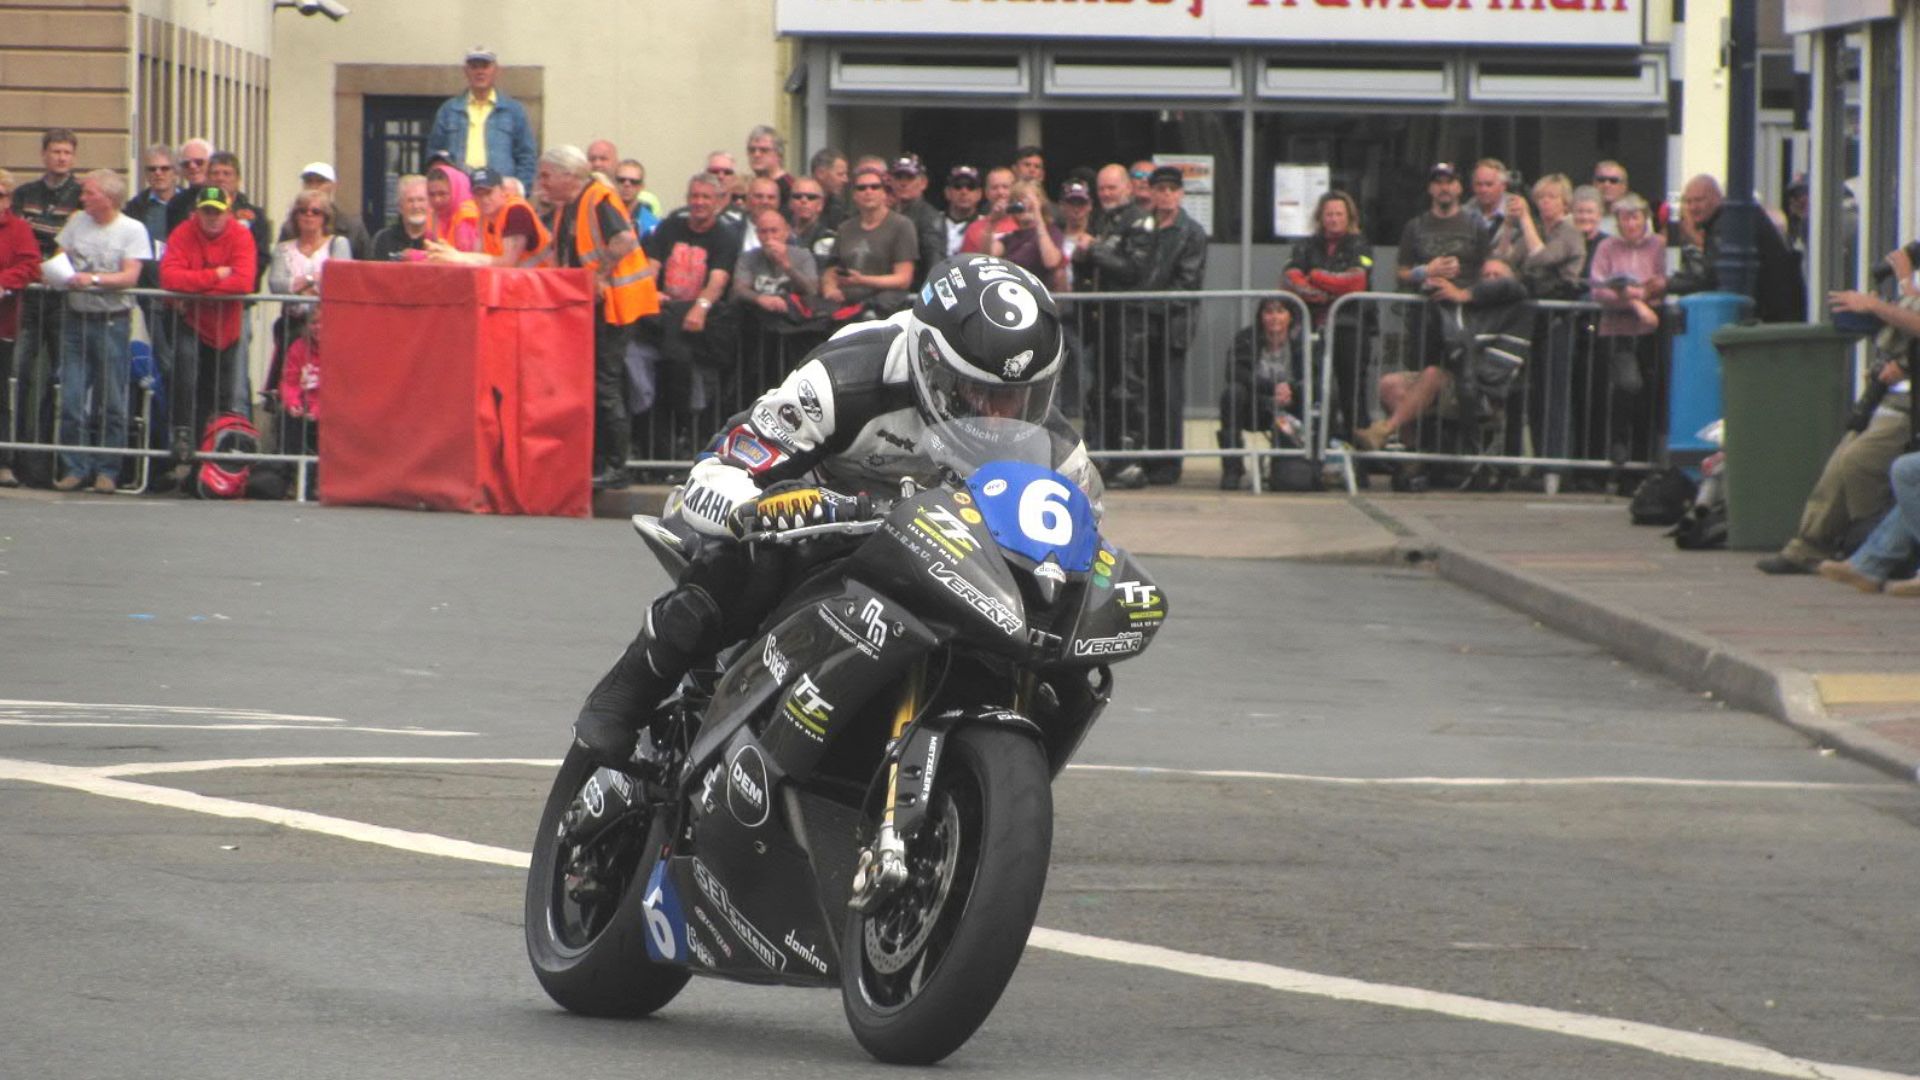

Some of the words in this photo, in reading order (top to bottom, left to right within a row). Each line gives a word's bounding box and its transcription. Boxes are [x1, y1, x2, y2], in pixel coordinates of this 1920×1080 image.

[1018, 479, 1073, 546] 6
[938, 548, 958, 565] MAN
[1114, 581, 1156, 609] TT
[1075, 637, 1142, 656] VERCAR
[795, 672, 834, 714] TT
[732, 761, 763, 805] DEM
[923, 736, 938, 792] METZELER
[642, 886, 677, 960] 6
[784, 929, 828, 974] domino
